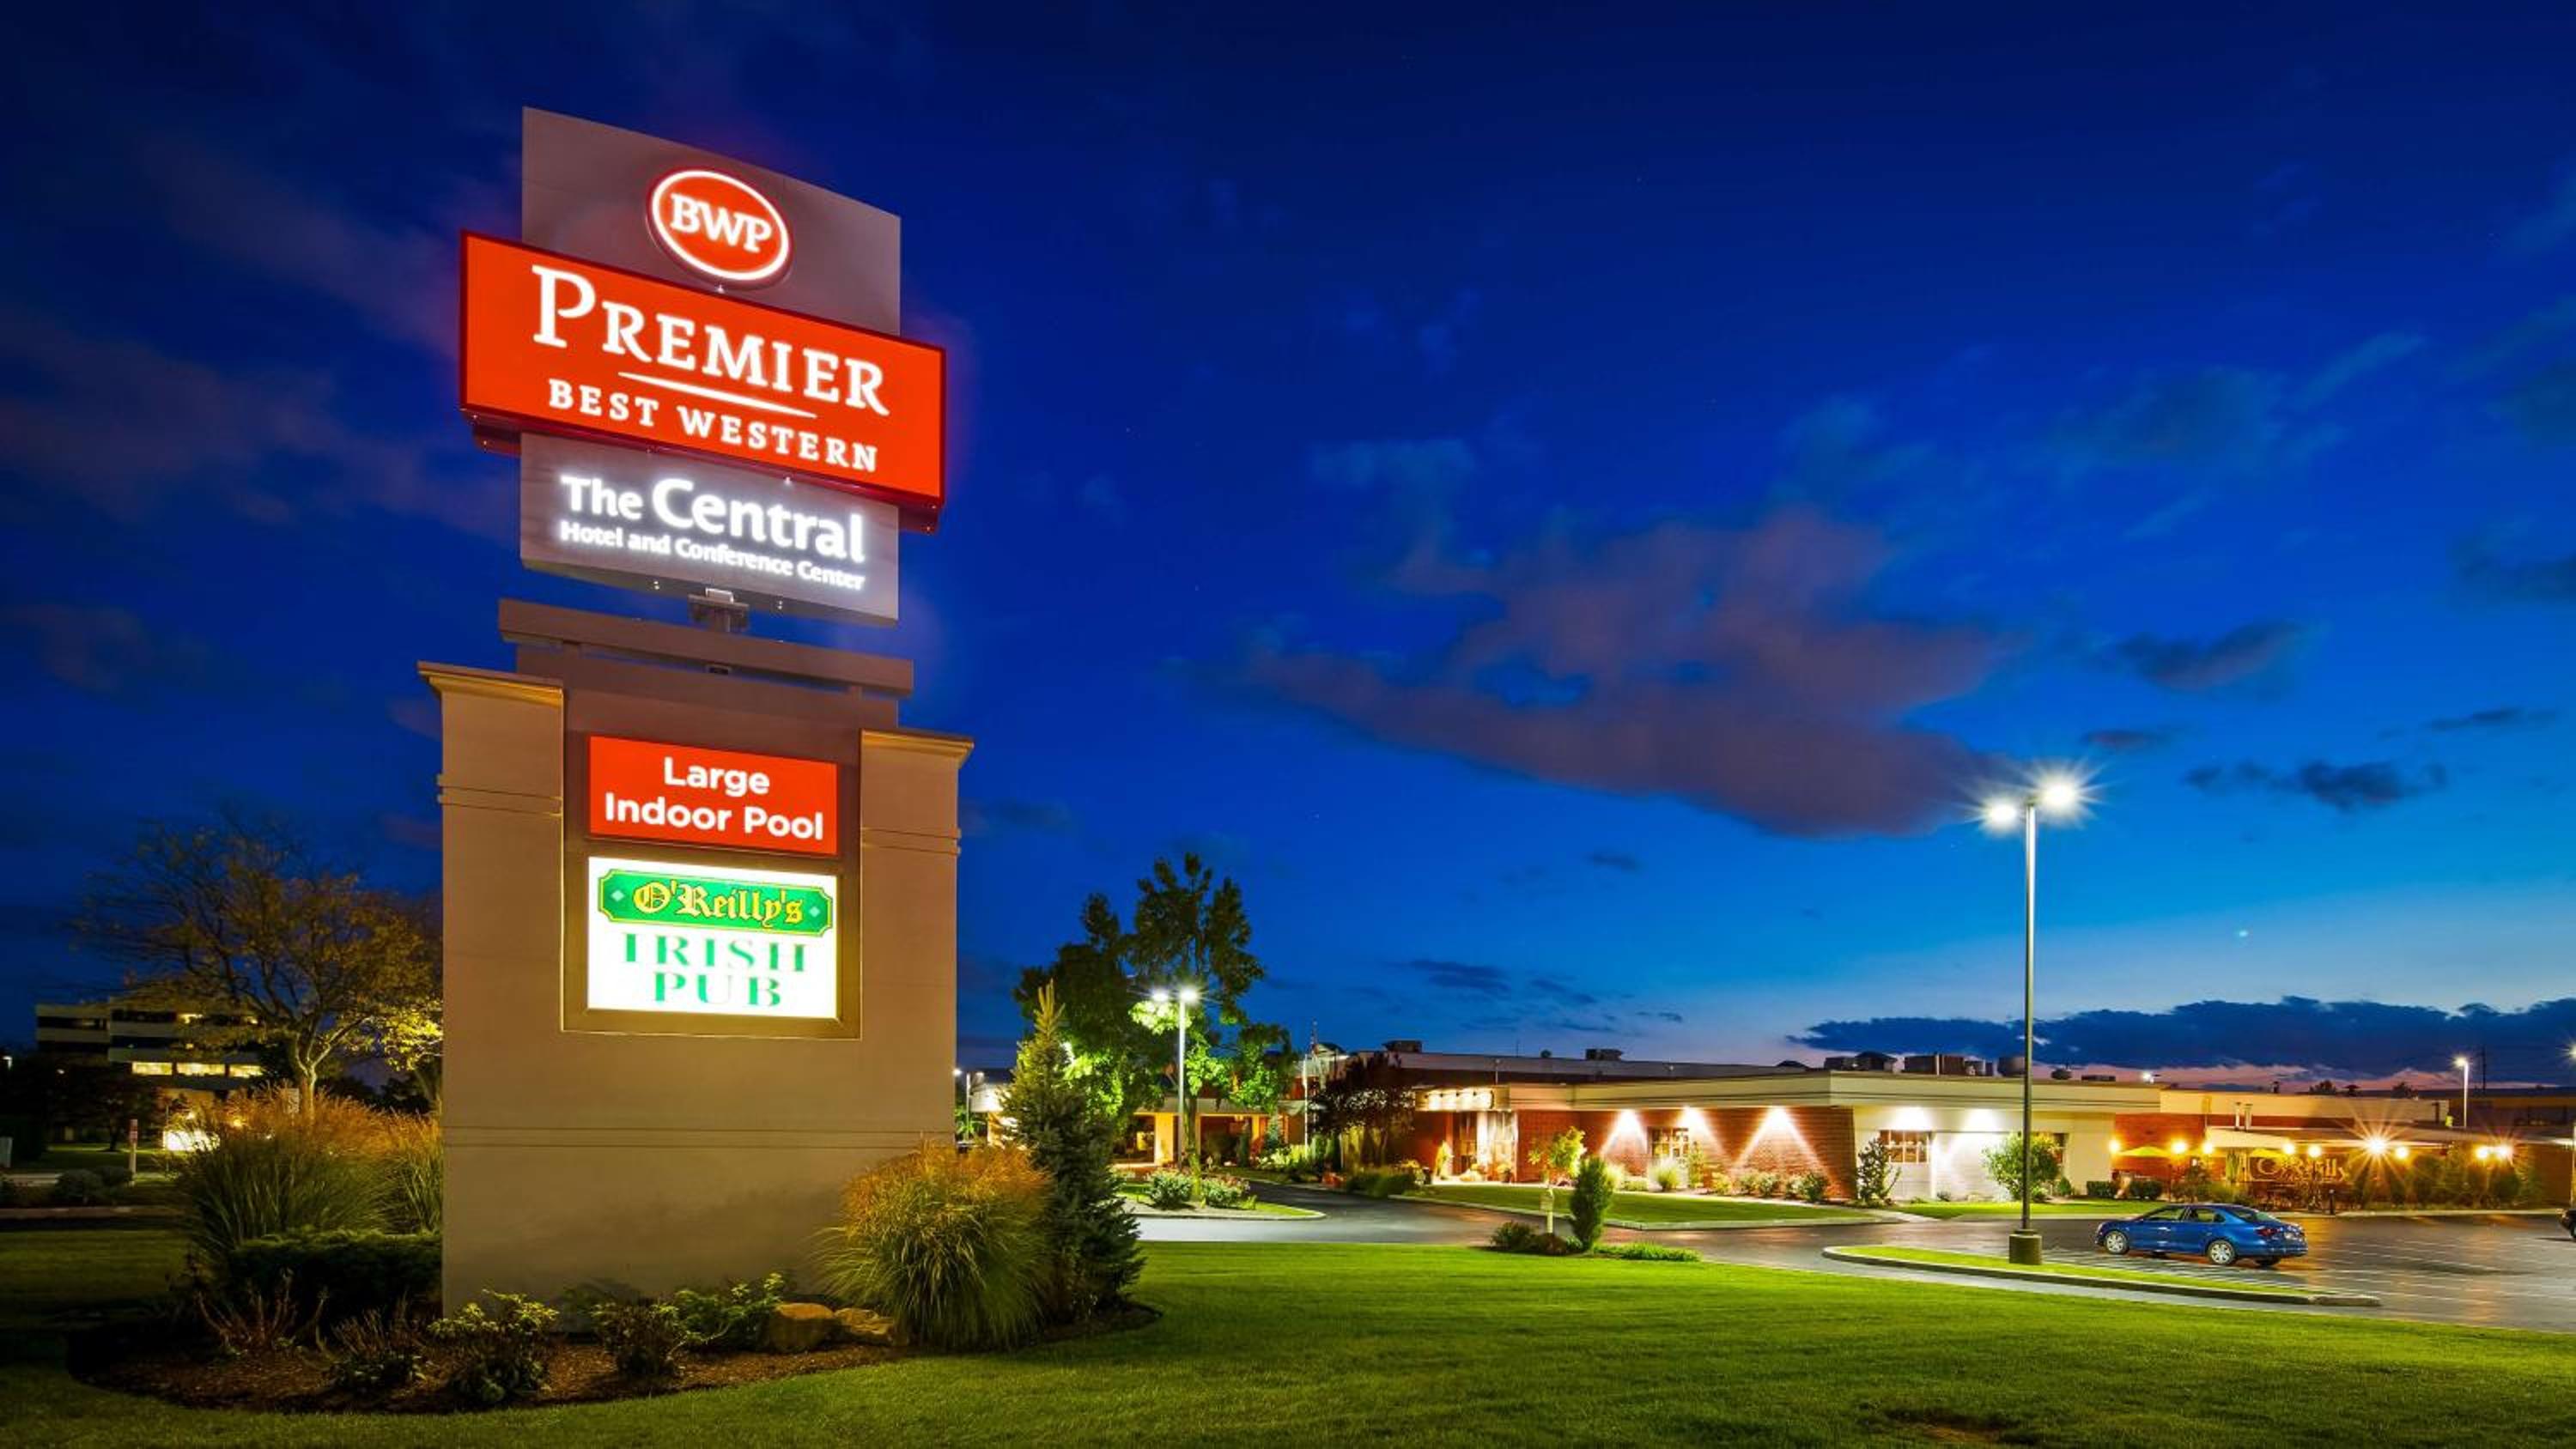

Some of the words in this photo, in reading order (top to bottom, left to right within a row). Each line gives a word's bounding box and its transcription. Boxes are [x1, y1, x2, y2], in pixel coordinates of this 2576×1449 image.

[670, 192, 773, 254] BWP
[532, 264, 890, 416] PREMIER
[548, 378, 659, 427] BEST
[677, 405, 878, 473] WESTERN
[561, 475, 643, 520] The
[652, 478, 866, 563] Central
[560, 520, 623, 548] Hotel
[627, 532, 671, 555] and
[674, 537, 794, 576] Conference
[797, 560, 866, 591] Center
[664, 756, 770, 797] Large
[605, 791, 732, 832] Indoor
[744, 805, 824, 840] Pool
[632, 879, 804, 929] O'Reilly's
[624, 933, 808, 973] IRISH
[653, 972, 782, 1008] PUB
